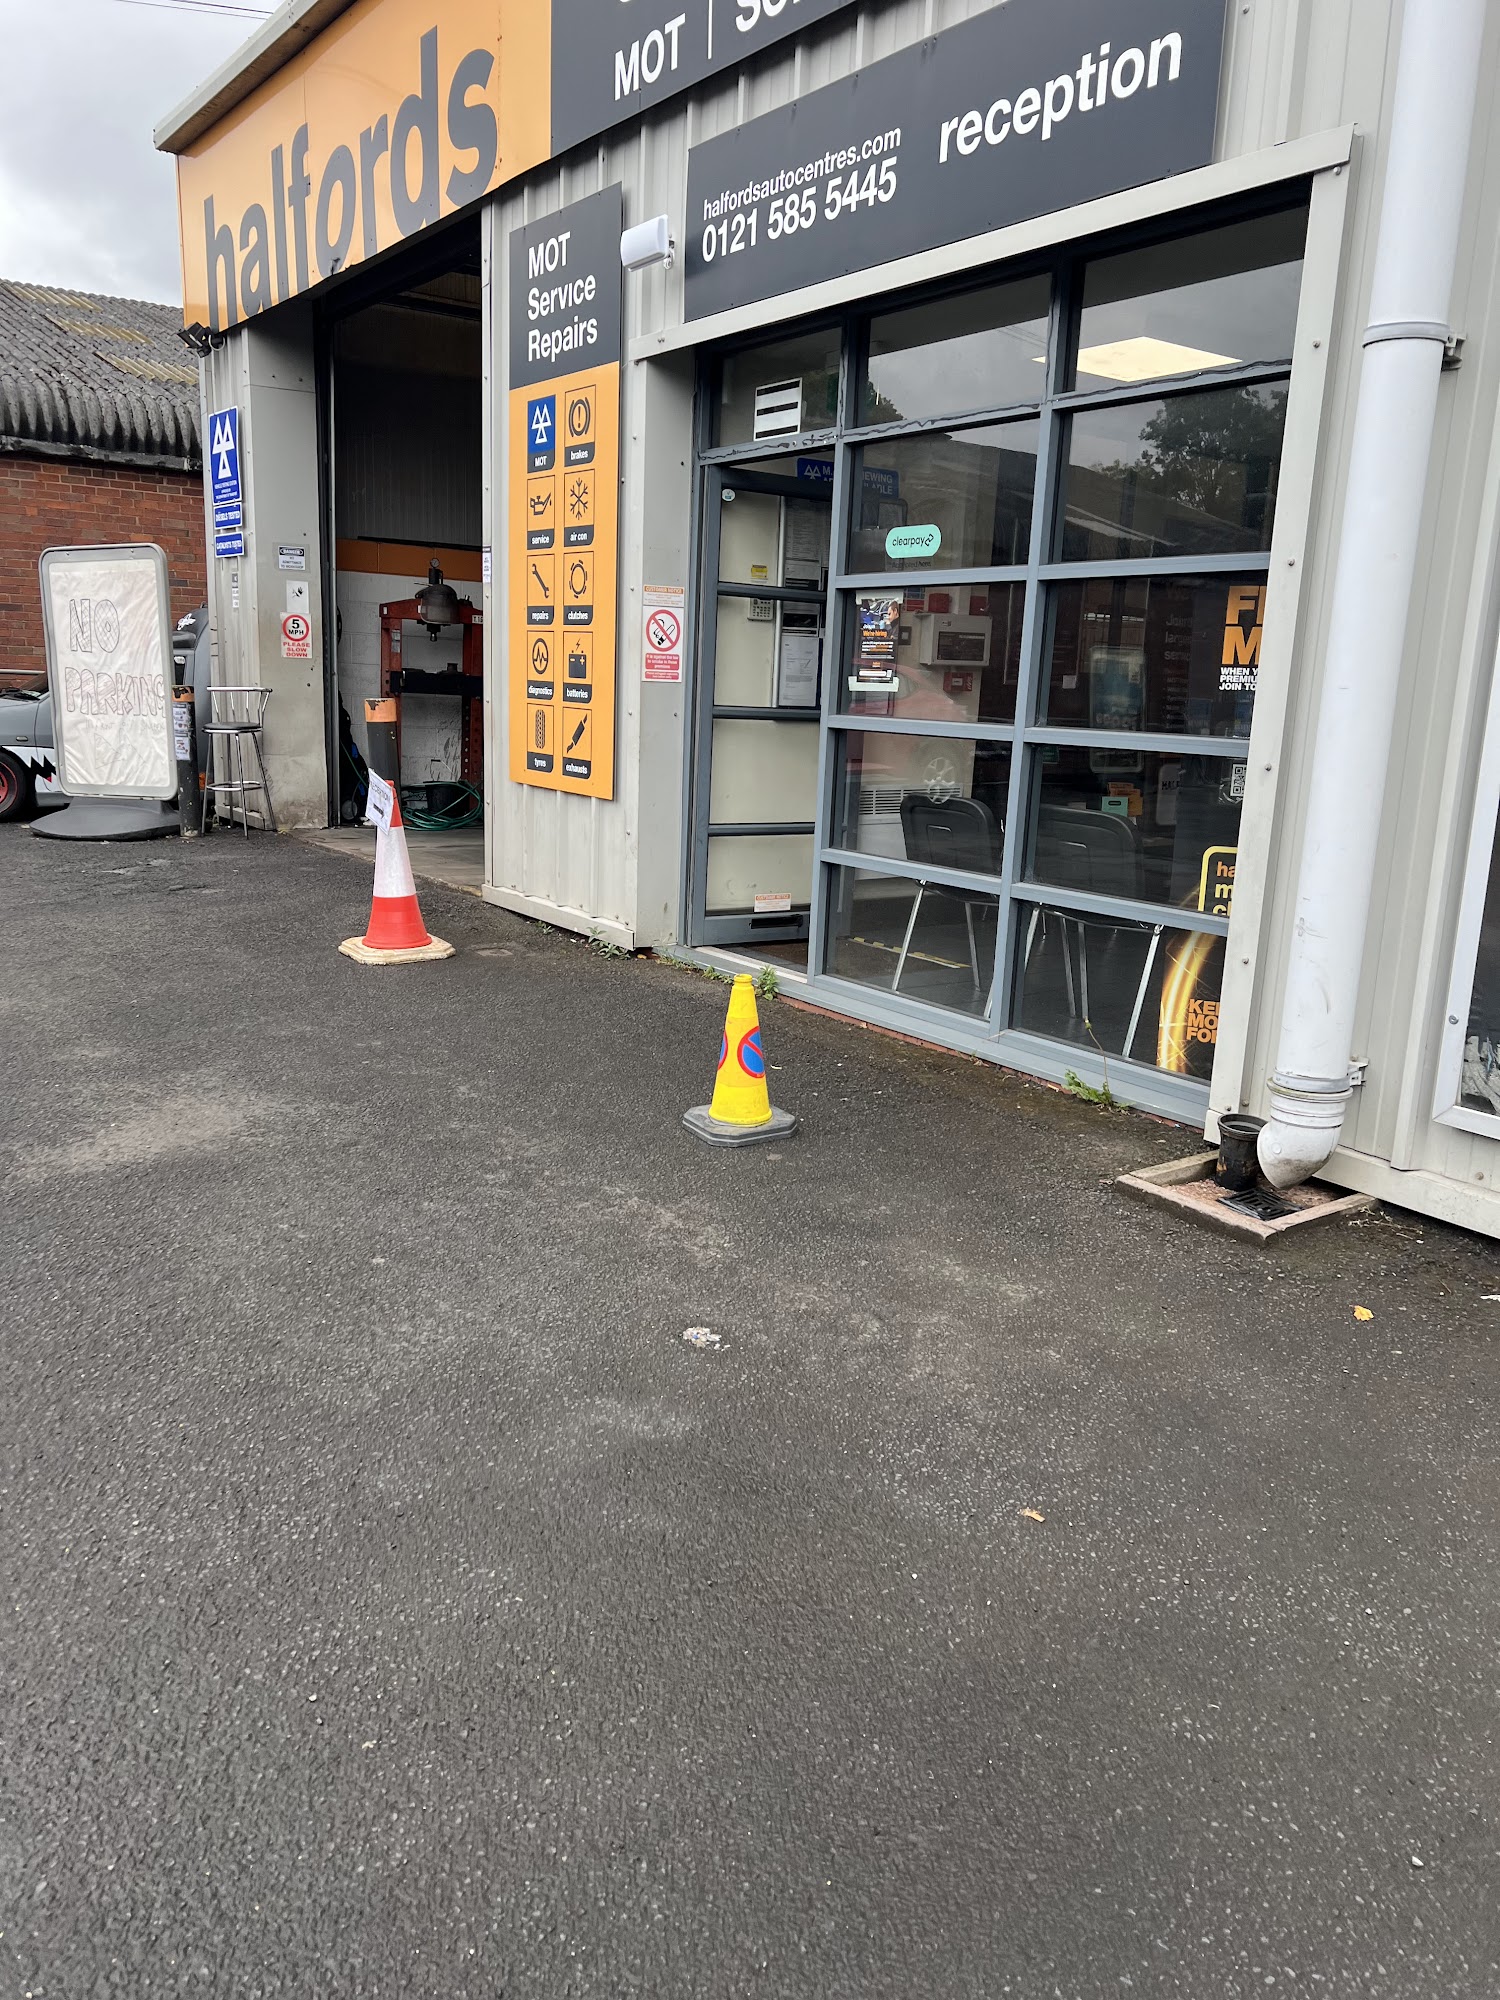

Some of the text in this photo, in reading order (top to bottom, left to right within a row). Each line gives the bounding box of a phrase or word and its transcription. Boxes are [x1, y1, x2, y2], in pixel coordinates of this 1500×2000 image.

[615, 13, 686, 101] MOT
[939, 31, 1182, 164] reception
[204, 25, 498, 332] halfords
[703, 127, 901, 221] halfordsautocentres.com
[702, 156, 897, 263] 0121 585 5445
[528, 231, 571, 279] MOT
[528, 274, 596, 321] Service
[528, 315, 598, 362] Repairs
[570, 449, 589, 460] brakes
[534, 456, 547, 467] MOT
[531, 534, 549, 544] service
[577, 533, 587, 541] con
[892, 536, 926, 548] clearpay
[532, 611, 549, 621] repairs
[568, 611, 589, 620] clutches
[69, 598, 121, 654] NO
[291, 618, 300, 629] 5
[1220, 667, 1250, 675] WHEN
[528, 685, 553, 696] diagnostics
[1218, 682, 1242, 690] JOIN
[65, 667, 167, 718] PARKING
[566, 688, 589, 699] batteries
[534, 758, 547, 768] tyres
[565, 763, 588, 775] exhausts
